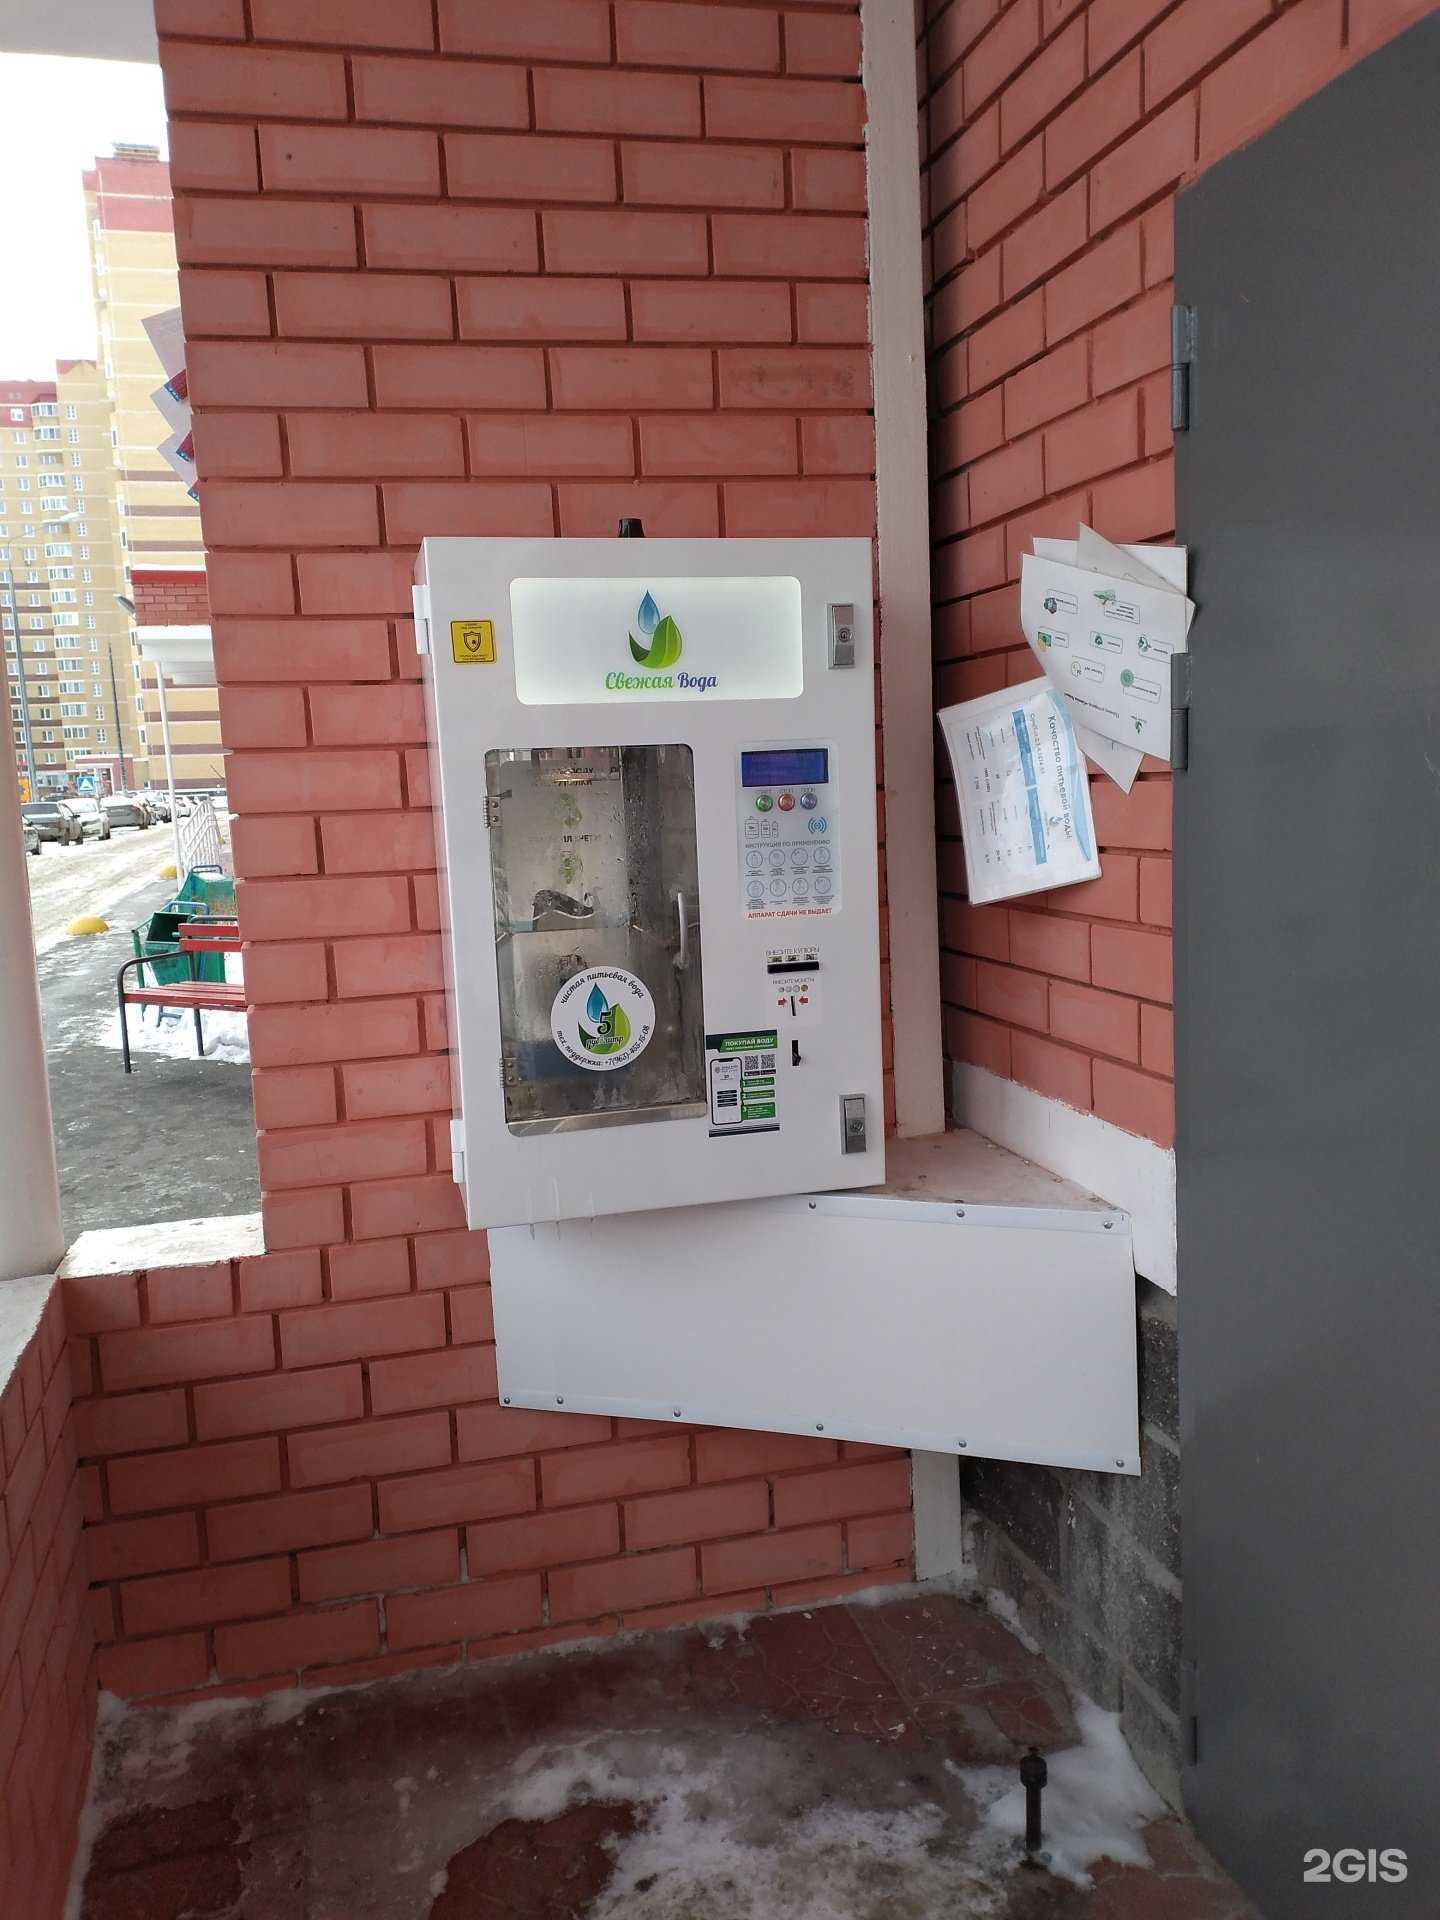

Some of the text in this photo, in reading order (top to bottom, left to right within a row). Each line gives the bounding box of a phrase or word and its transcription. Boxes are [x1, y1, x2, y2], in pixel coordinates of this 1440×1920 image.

[605, 671, 718, 692] Свежая Вода
[747, 911, 775, 919] АППАРАТ
[808, 907, 832, 915] ВЫДАЕТ
[560, 971, 645, 1004] чистая питьевая вода
[597, 1010, 612, 1035] 5
[725, 1038, 756, 1047] ПОКУПАЙ
[756, 1037, 774, 1045] ВОДУ
